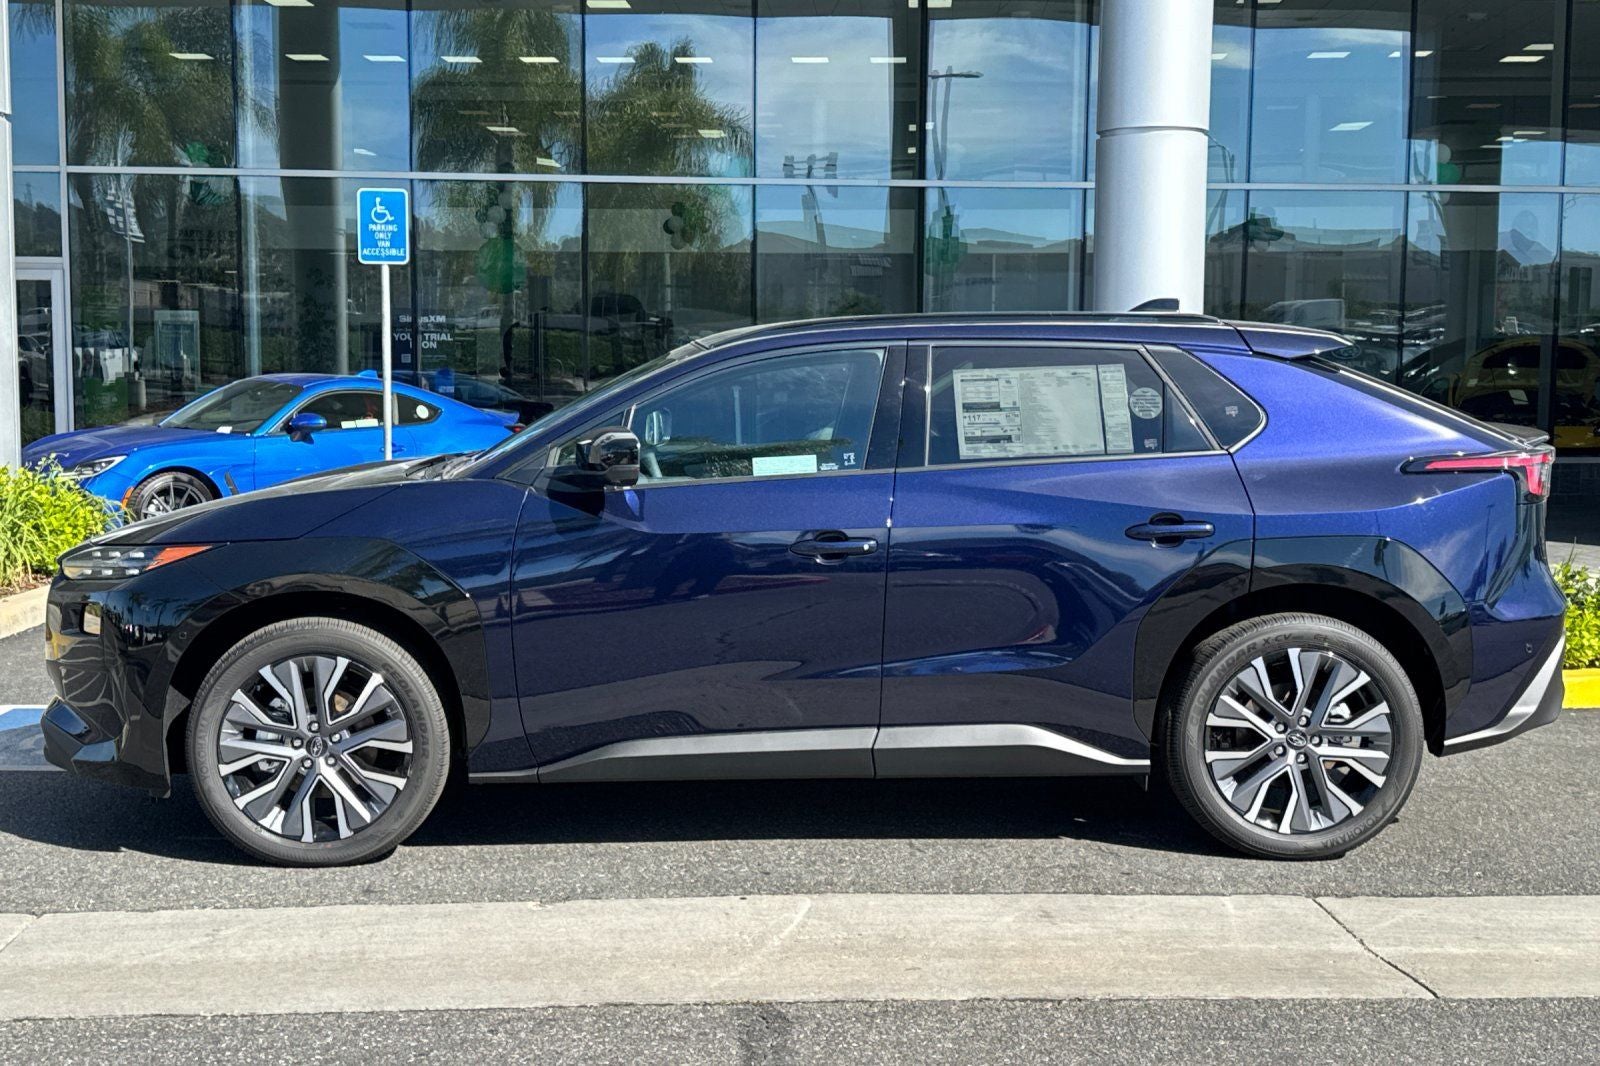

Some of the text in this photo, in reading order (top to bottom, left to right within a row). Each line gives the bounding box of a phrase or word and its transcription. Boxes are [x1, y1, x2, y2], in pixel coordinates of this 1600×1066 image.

[368, 224, 398, 232] PARKING
[374, 232, 392, 240] ONLY
[377, 240, 391, 248] VAN
[362, 248, 405, 257] ACCESSIBLE
[393, 333, 453, 341] YOU TRIAL
[421, 341, 437, 349] ON
